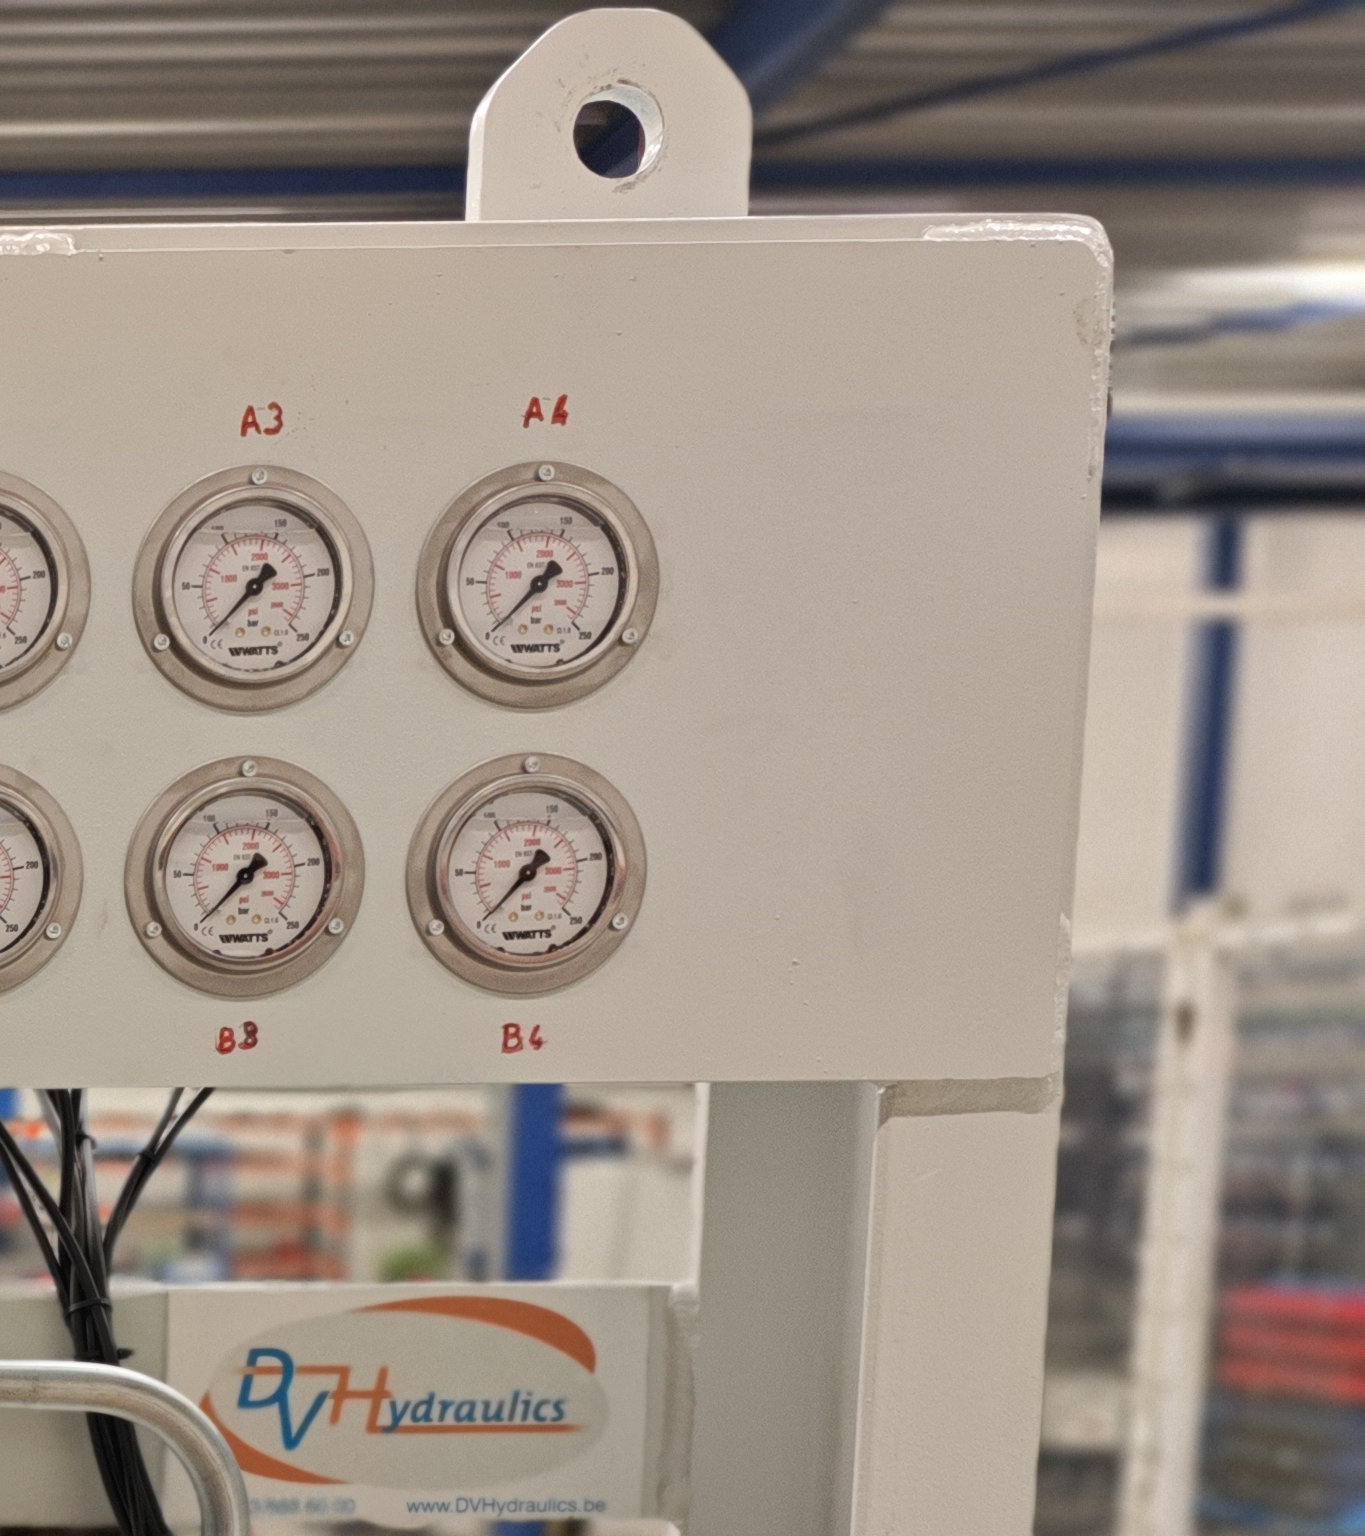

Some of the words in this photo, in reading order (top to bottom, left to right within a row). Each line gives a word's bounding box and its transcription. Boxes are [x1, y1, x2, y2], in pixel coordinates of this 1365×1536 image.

[240, 402, 283, 437] A3
[248, 619, 258, 627] bar
[531, 616, 541, 624] bar
[229, 645, 278, 656] WATTS
[511, 643, 560, 653] WATTS
[238, 907, 249, 915] bar
[521, 903, 532, 911] bar
[219, 933, 268, 944] WATTS
[502, 930, 552, 940] WATTS
[500, 1023, 547, 1054] B4
[406, 1497, 606, 1517] www.DVHydraulics.be
